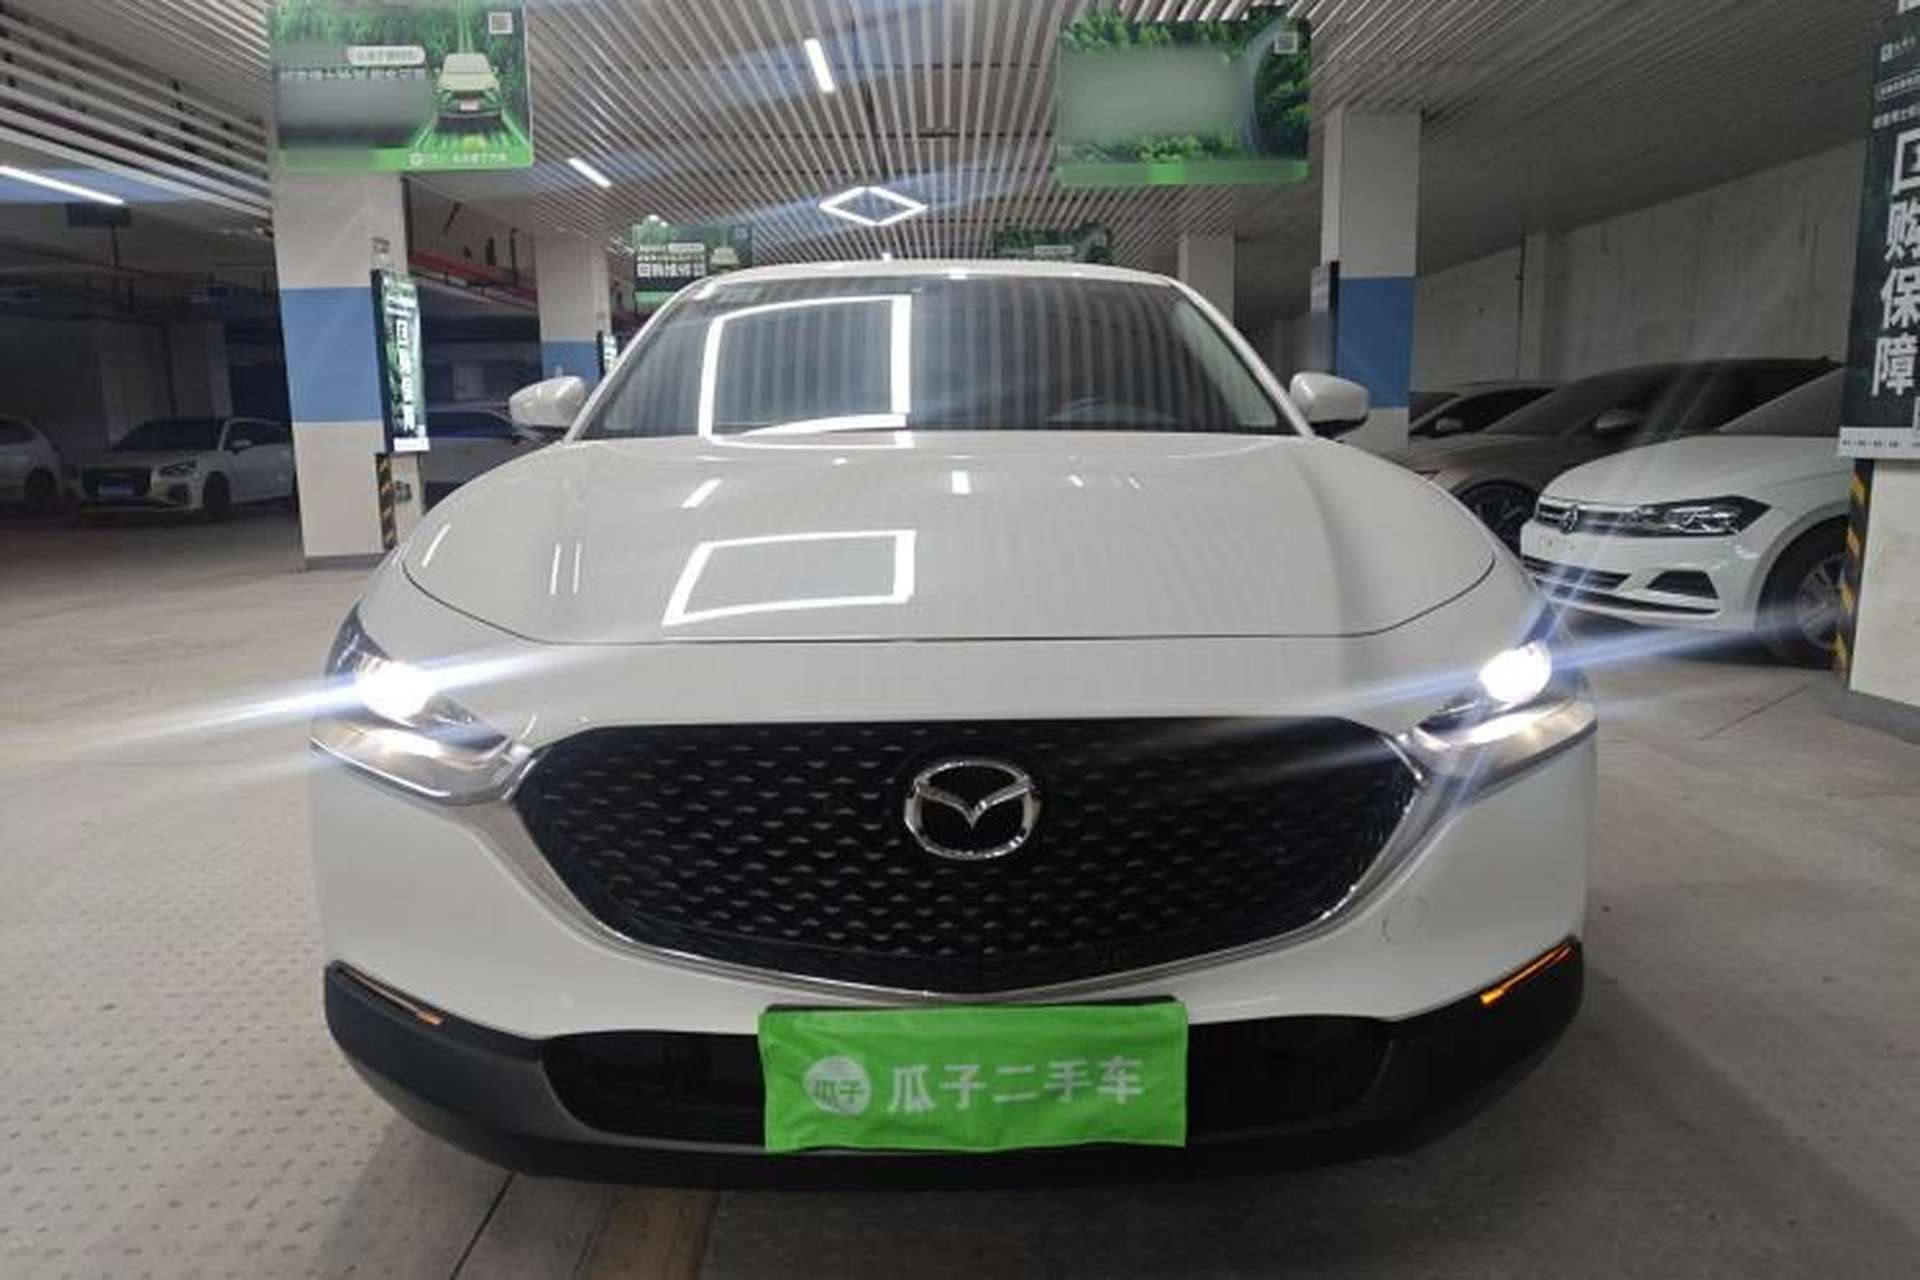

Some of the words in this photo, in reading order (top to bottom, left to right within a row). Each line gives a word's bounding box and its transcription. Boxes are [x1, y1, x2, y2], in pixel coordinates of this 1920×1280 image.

[815, 1079, 865, 1108] 瓜子
[887, 1055, 1144, 1114] 瓜子二手车
